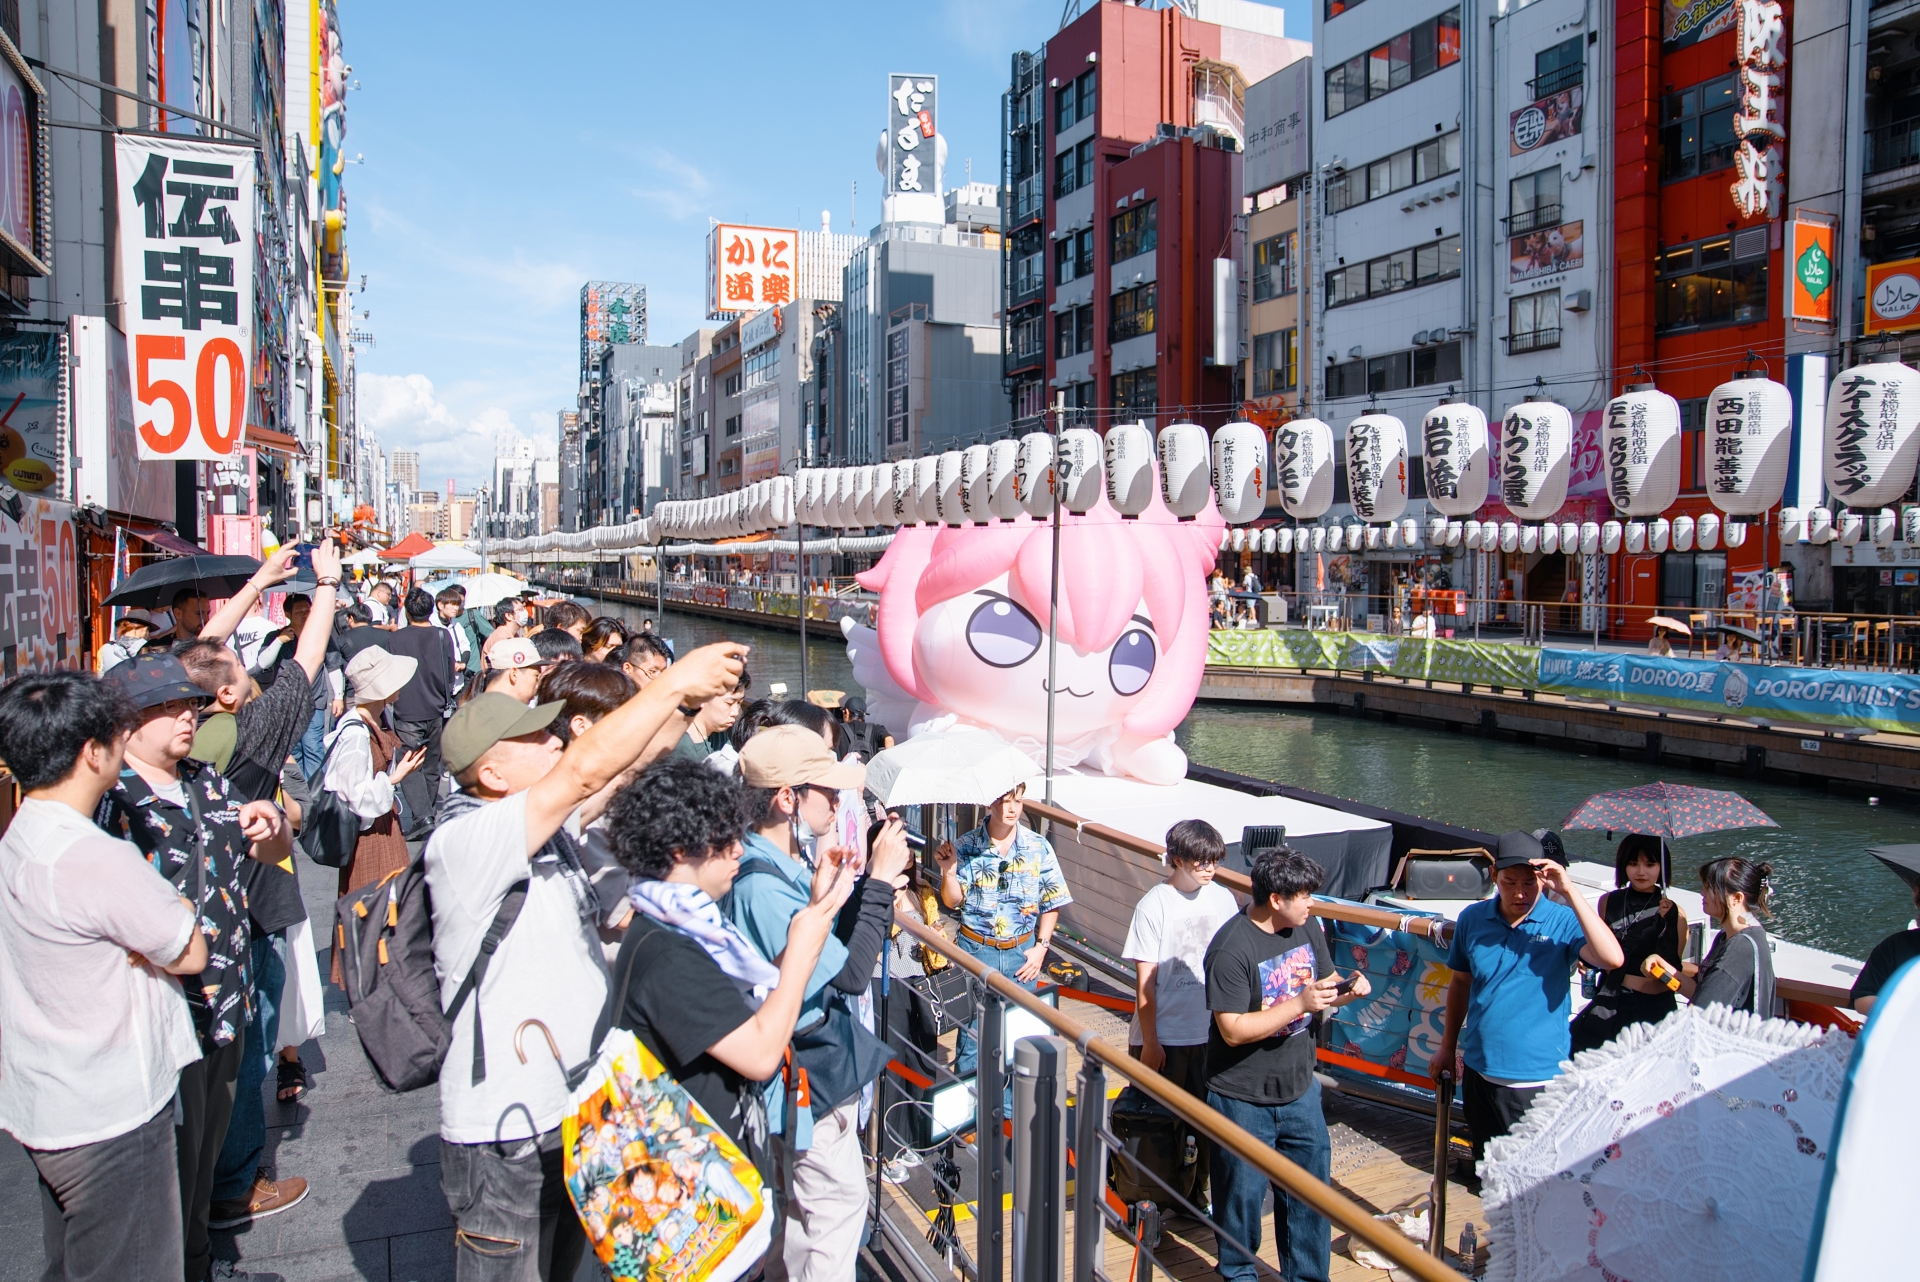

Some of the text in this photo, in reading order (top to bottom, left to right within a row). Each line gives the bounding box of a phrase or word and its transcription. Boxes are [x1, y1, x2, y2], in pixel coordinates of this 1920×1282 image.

[893, 78, 934, 192] だるま
[1248, 111, 1301, 148] 中和商事
[132, 152, 241, 331] 伝串
[725, 234, 790, 270] かに
[1513, 262, 1557, 282] MAMESHIBA
[1806, 276, 1823, 285] HALAL
[1876, 285, 1919, 307] حلال
[1881, 304, 1912, 314] HALAL
[135, 333, 246, 454] 50
[1424, 416, 1458, 500] 岩橋
[1503, 413, 1532, 508] かつら屋
[1608, 401, 1631, 508] EL RODEO
[1714, 398, 1745, 494] 西田龍善堂
[1833, 375, 1877, 496] ナイスクラップ
[1057, 438, 1073, 504] ヒカリ
[1222, 438, 1236, 499] 心斎橋筋商店街
[1278, 428, 1300, 510] カツモト
[41, 519, 79, 647] 50
[1901, 548, 1920, 560] SI
[238, 631, 258, 643] NIKE
[1544, 659, 1573, 675] NIKKE
[1754, 679, 1904, 708] DOROFAMILY
[1356, 983, 1403, 1034] NIKKE
